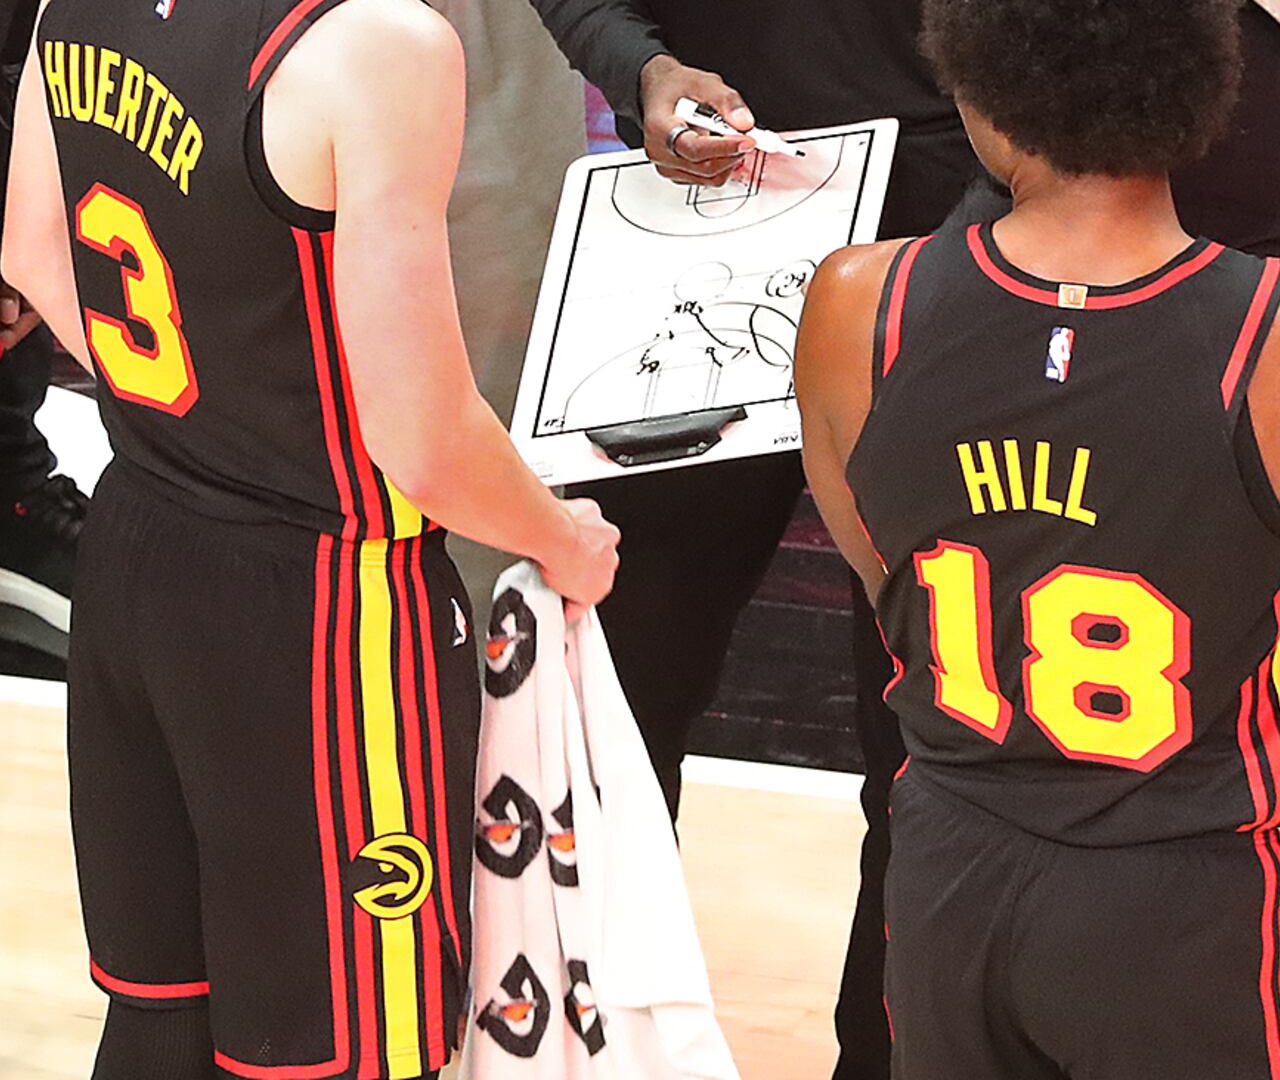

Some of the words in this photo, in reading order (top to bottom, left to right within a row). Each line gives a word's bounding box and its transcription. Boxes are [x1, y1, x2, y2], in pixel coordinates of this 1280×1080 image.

[44, 40, 204, 196] HUERTER
[75, 180, 200, 418] 3
[955, 438, 1098, 527] HILL
[913, 538, 1193, 773] 18
